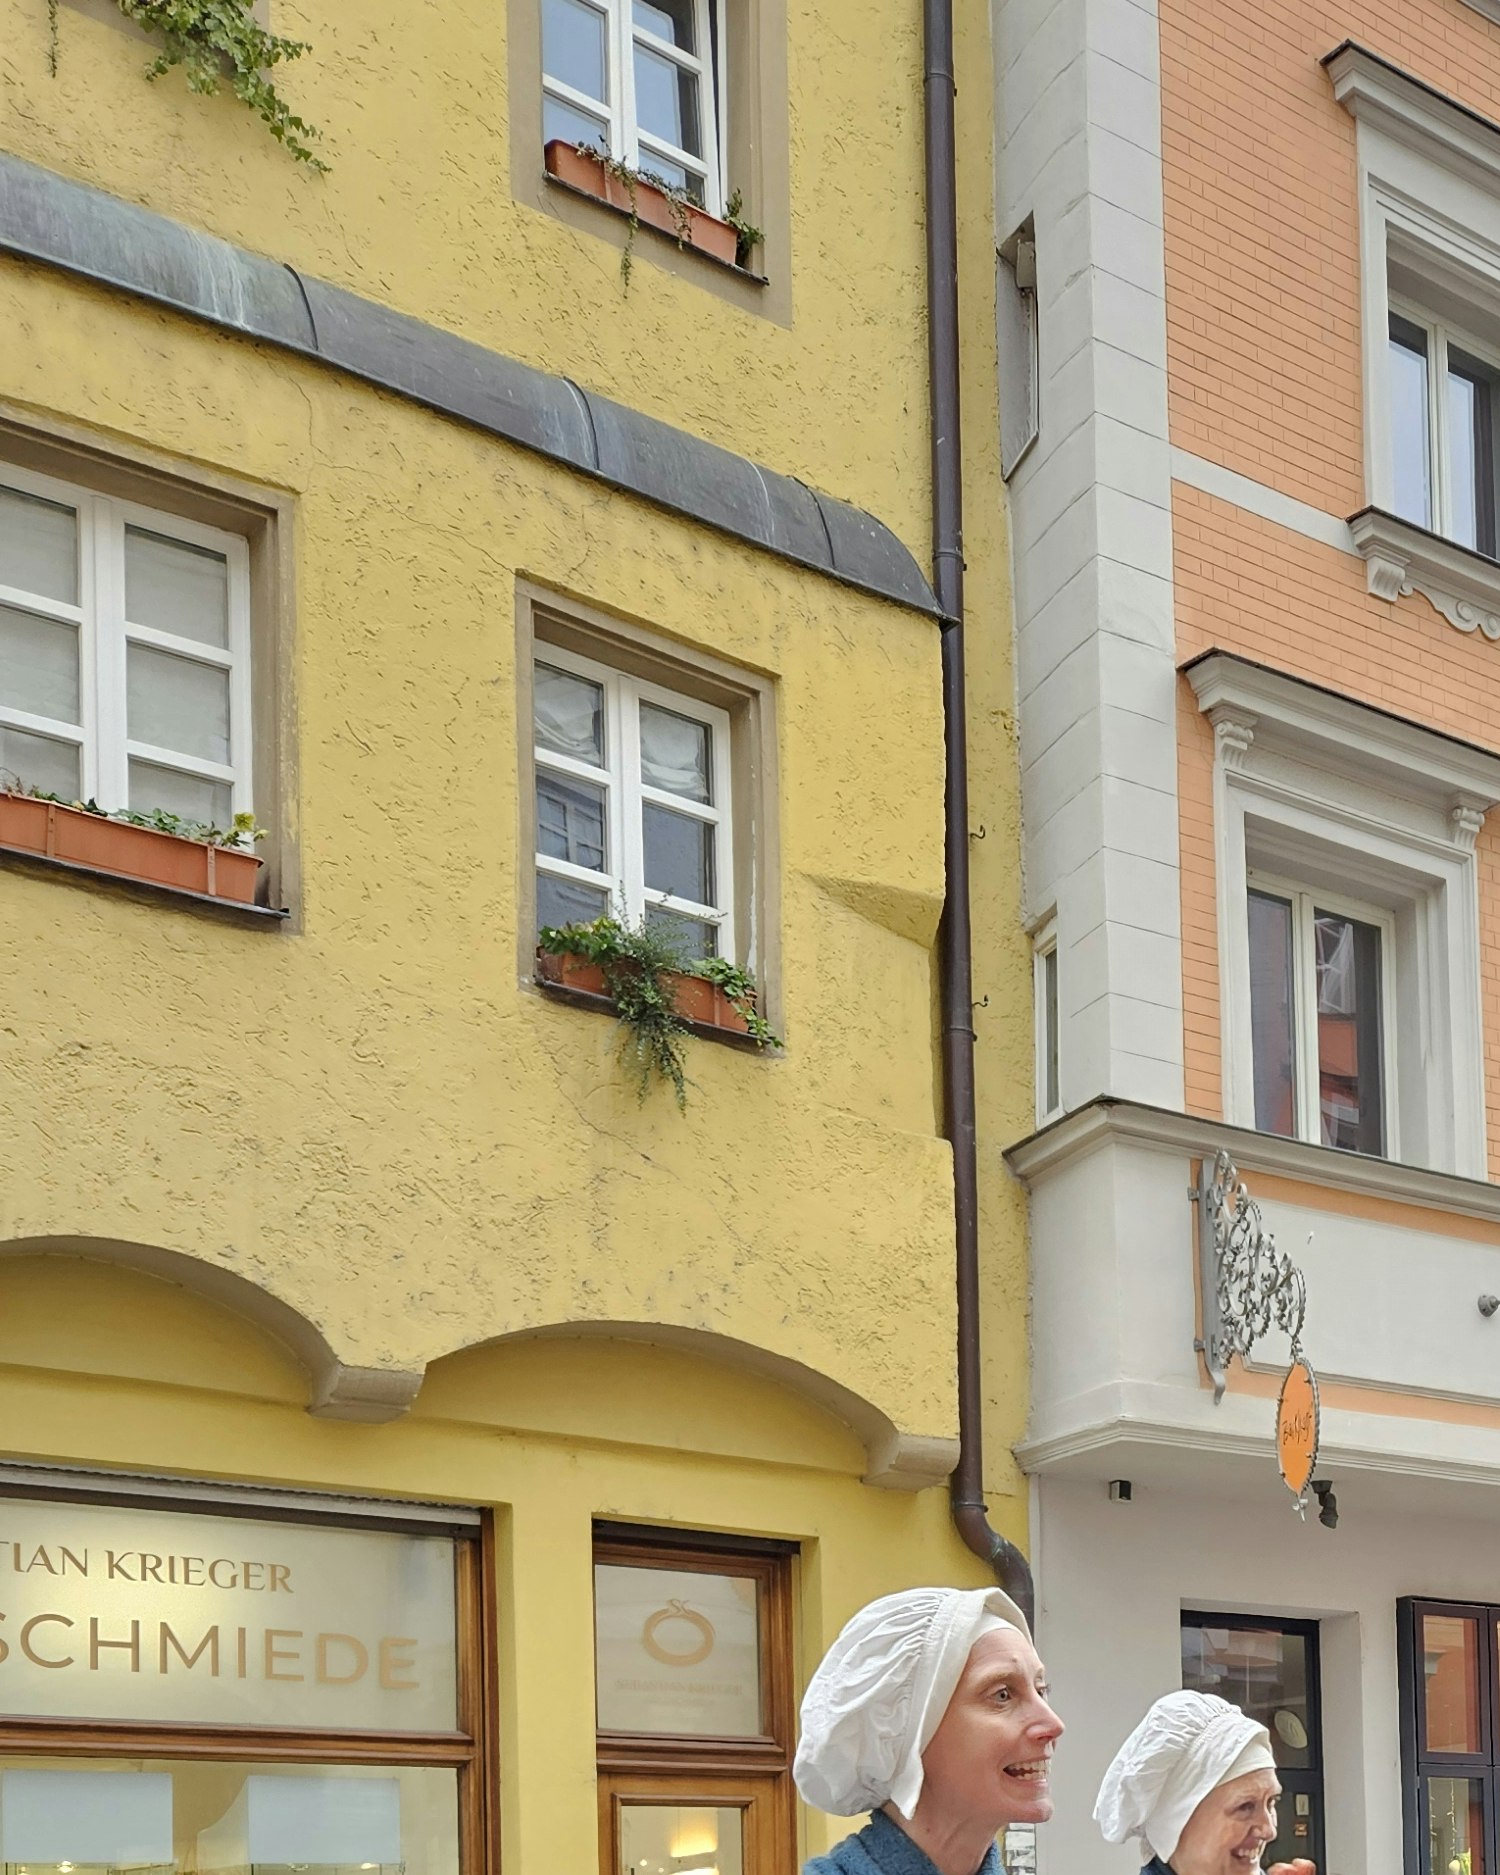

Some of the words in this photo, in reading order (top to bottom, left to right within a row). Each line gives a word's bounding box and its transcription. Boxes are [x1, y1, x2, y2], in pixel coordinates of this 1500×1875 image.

[0, 1541, 88, 1577] IAN
[104, 1549, 294, 1594] KRIEGER
[0, 1612, 420, 1691] CHMIEDE
